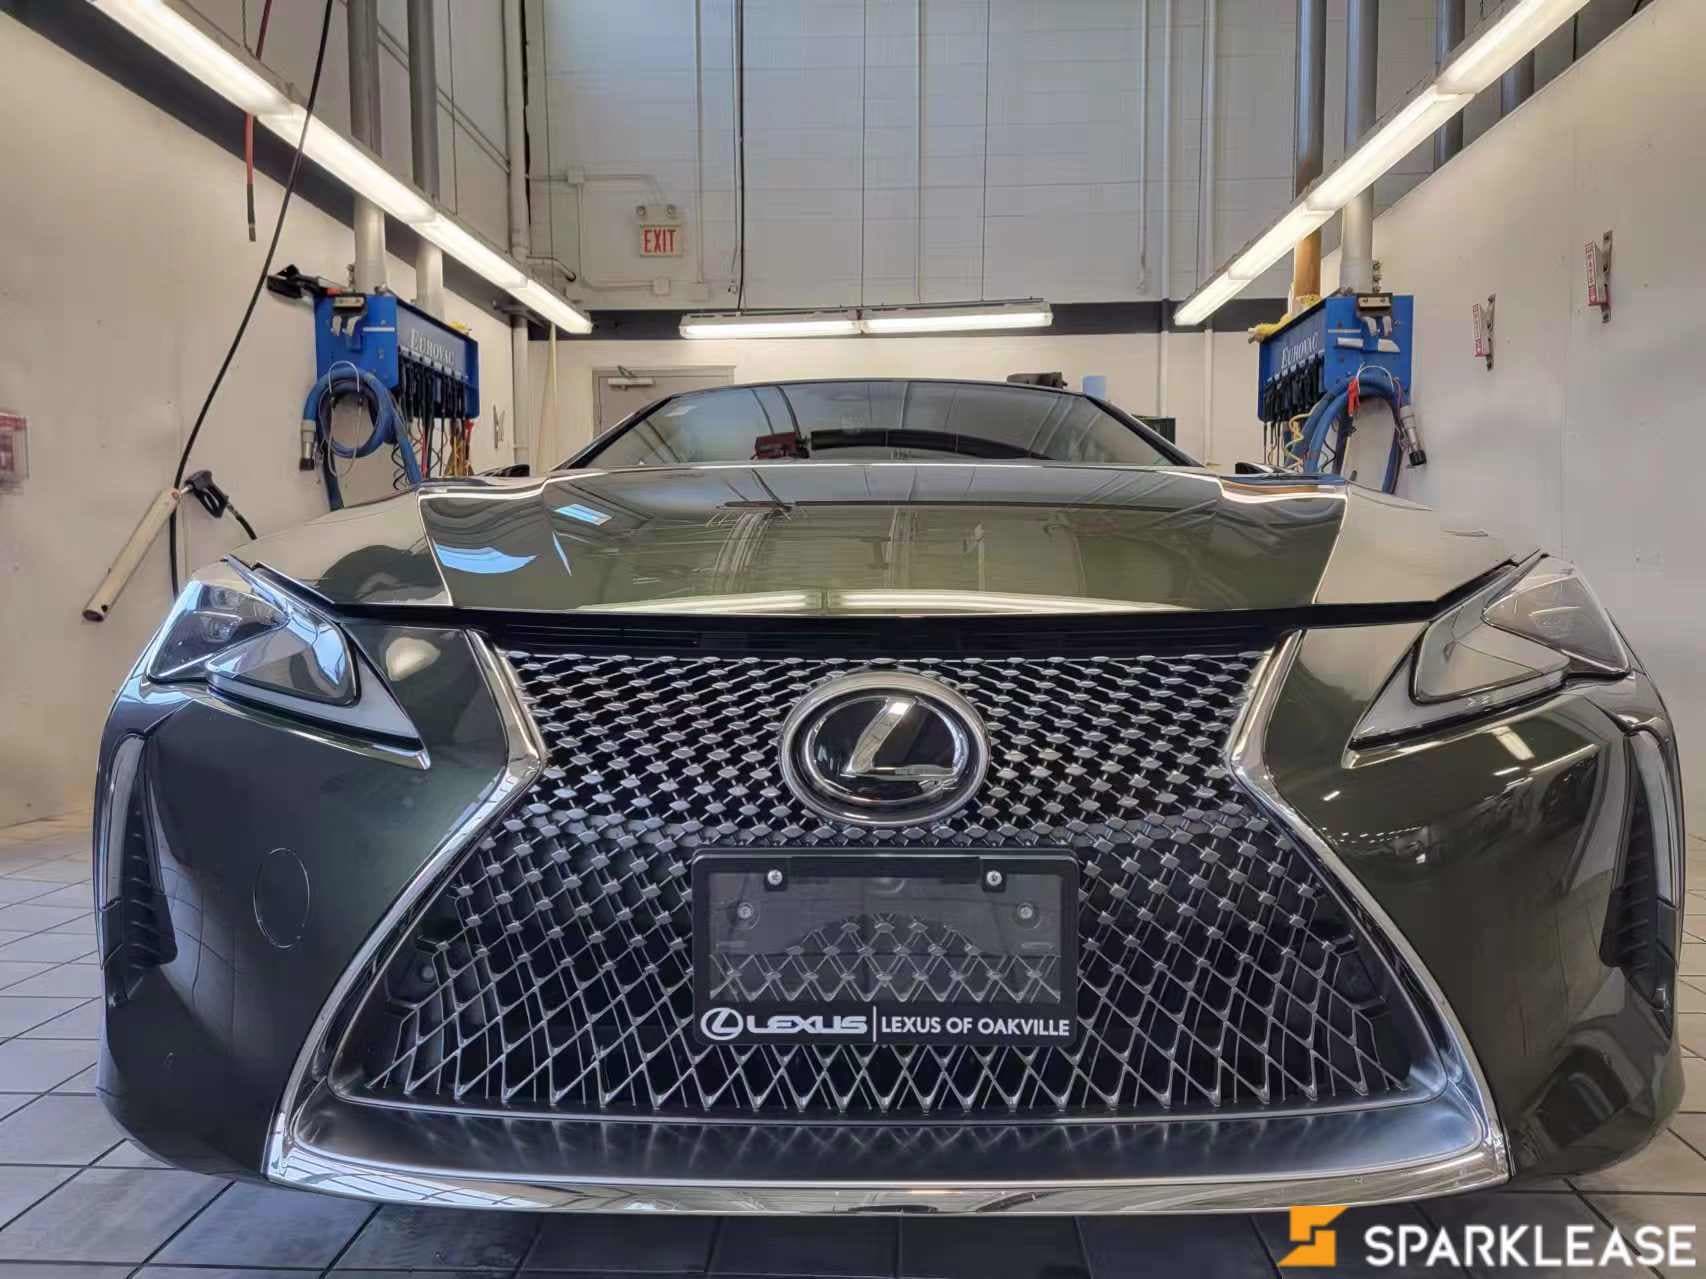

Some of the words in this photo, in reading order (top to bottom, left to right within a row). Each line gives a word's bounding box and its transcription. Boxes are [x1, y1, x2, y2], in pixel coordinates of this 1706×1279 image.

[643, 229, 677, 252] EXIT
[410, 328, 456, 366] EUROVAC
[1281, 333, 1319, 368] EUROVAC
[748, 1015, 868, 1034] LEXUS
[881, 1016, 941, 1034] LEXUS
[945, 1016, 973, 1034] OF
[977, 1017, 1070, 1036] OAKVILLE
